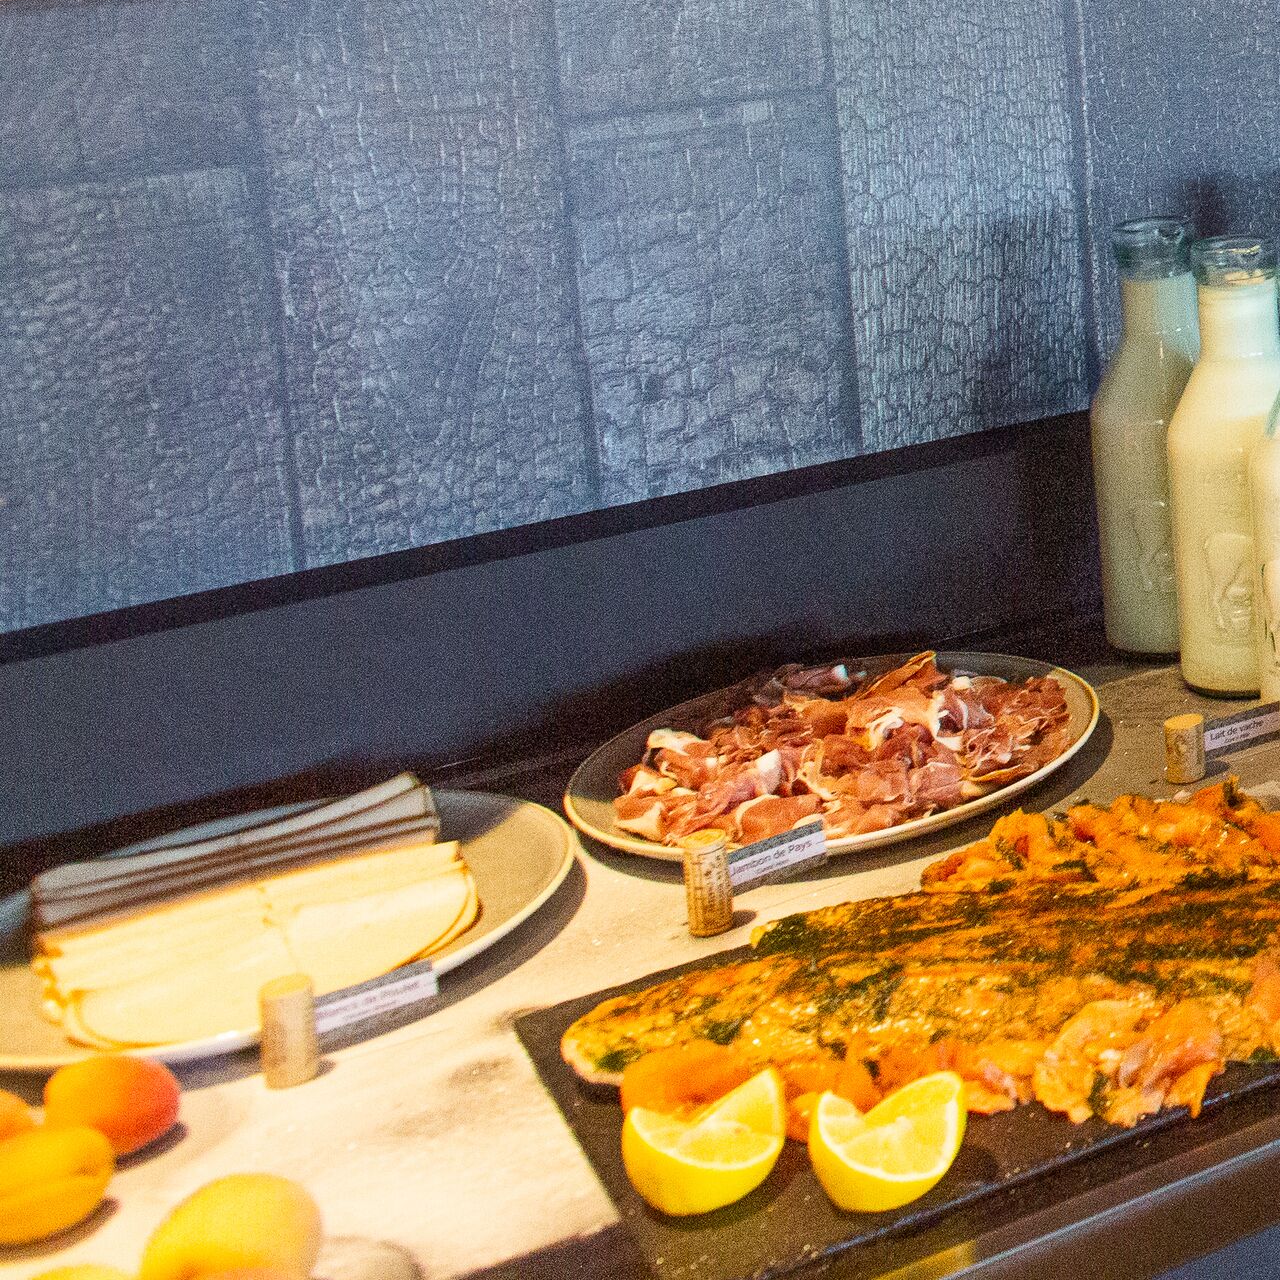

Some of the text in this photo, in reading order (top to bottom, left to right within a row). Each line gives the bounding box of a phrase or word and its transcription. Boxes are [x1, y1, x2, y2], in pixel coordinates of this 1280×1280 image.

[1226, 726, 1238, 736] de
[773, 849, 786, 860] de
[788, 839, 813, 854] Pays
